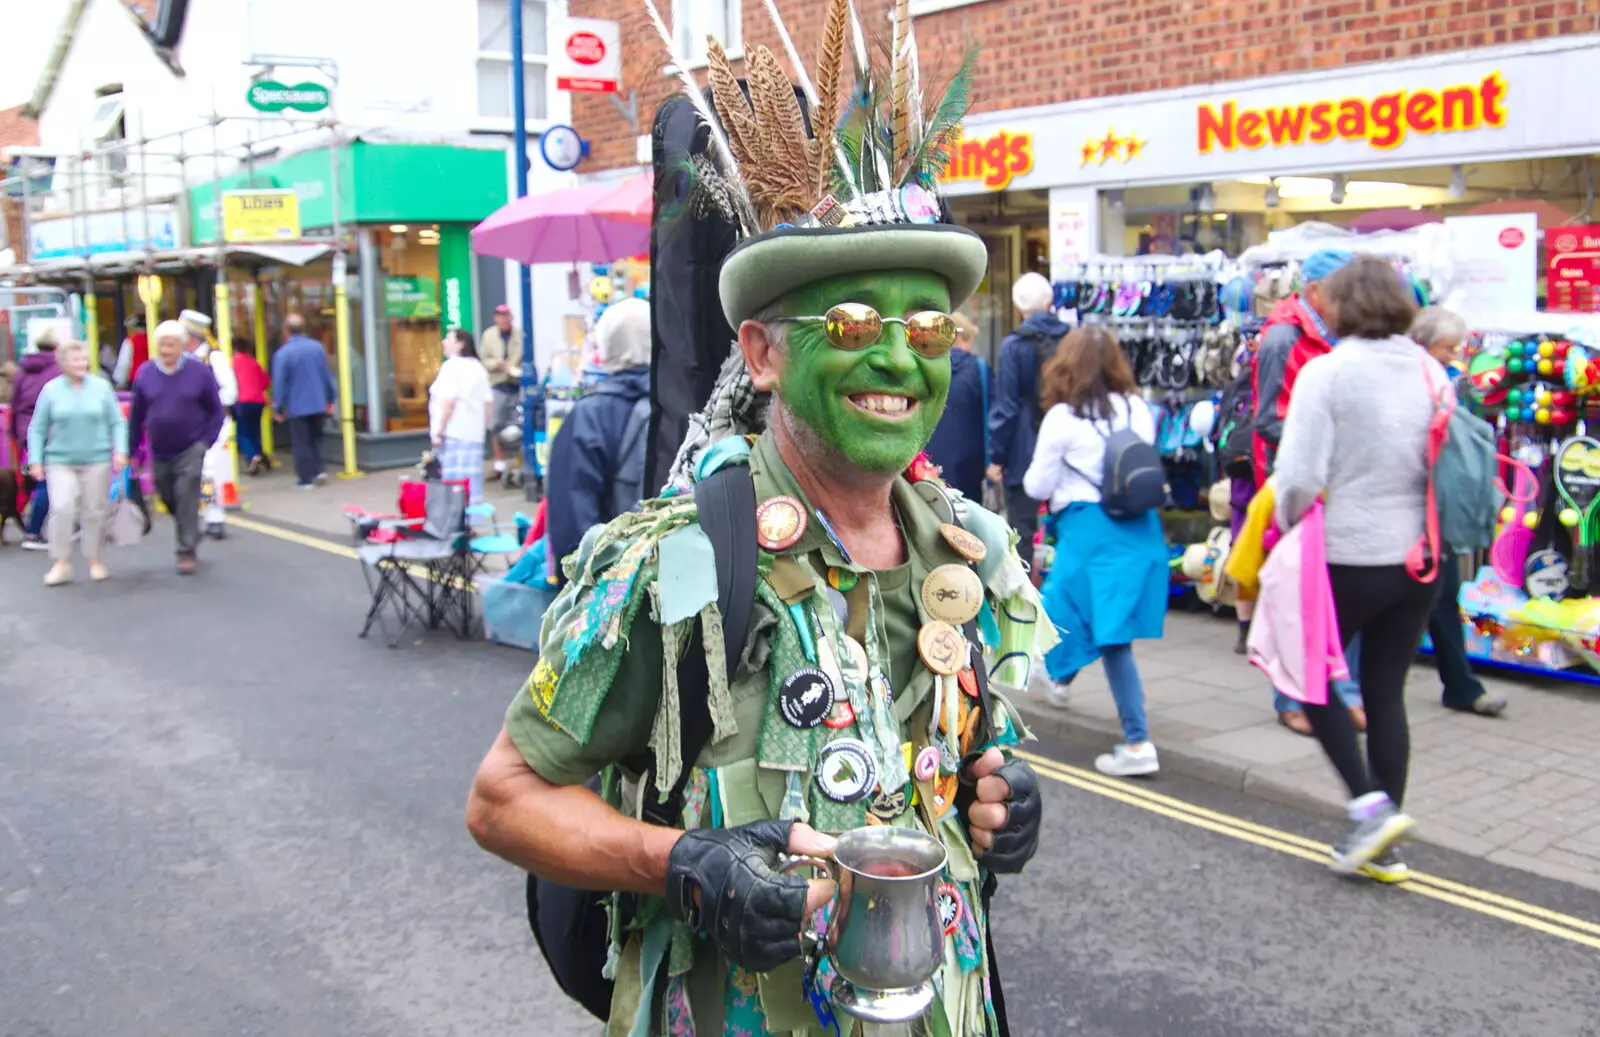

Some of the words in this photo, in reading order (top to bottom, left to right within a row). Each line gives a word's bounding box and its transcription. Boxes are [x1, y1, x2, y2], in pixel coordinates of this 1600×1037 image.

[252, 86, 327, 106] Specsavers
[1196, 70, 1507, 154] Newsagent
[783, 667, 818, 687] ROCHESTER
